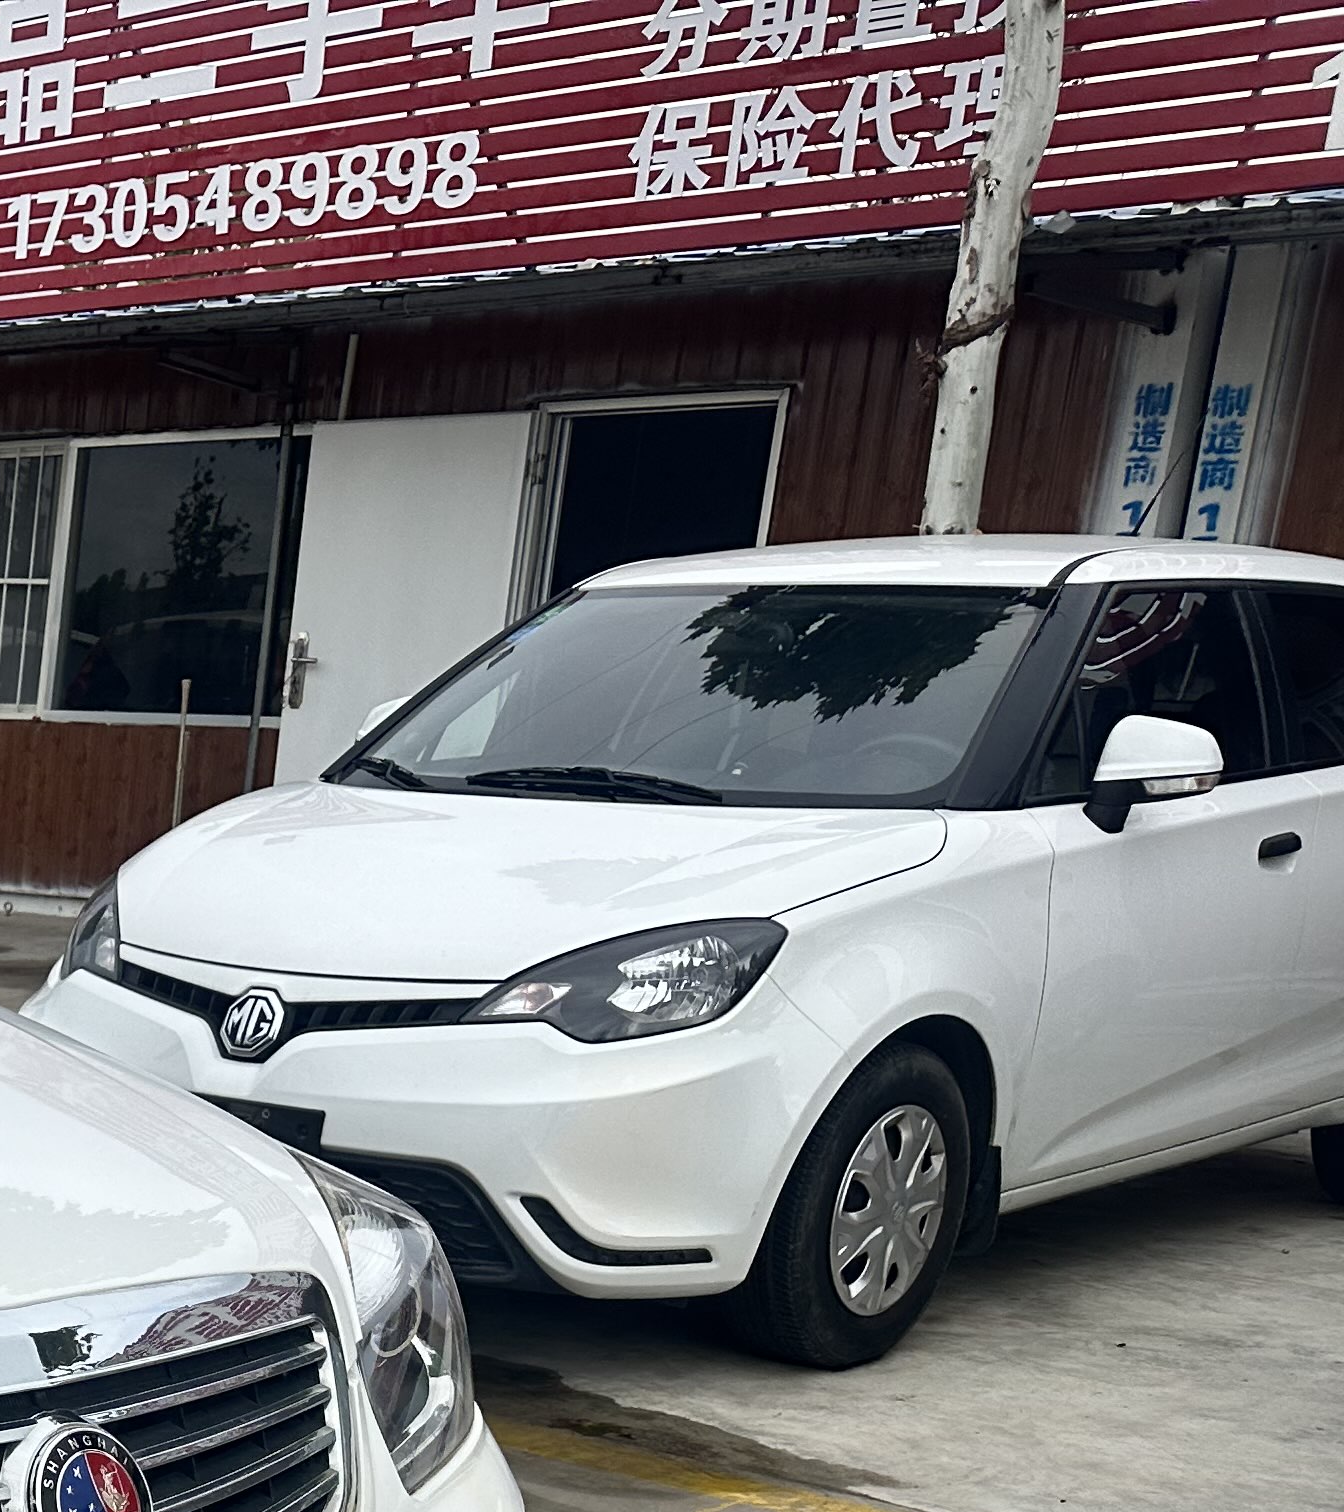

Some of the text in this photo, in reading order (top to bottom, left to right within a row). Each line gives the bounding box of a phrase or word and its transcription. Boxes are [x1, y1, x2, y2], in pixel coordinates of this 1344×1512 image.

[628, 54, 1006, 200] 保险代理
[7, 132, 481, 259] 17305489898
[1198, 383, 1253, 492] 制造商
[227, 998, 273, 1045] MG
[43, 1434, 131, 1490] SHANGHAI
